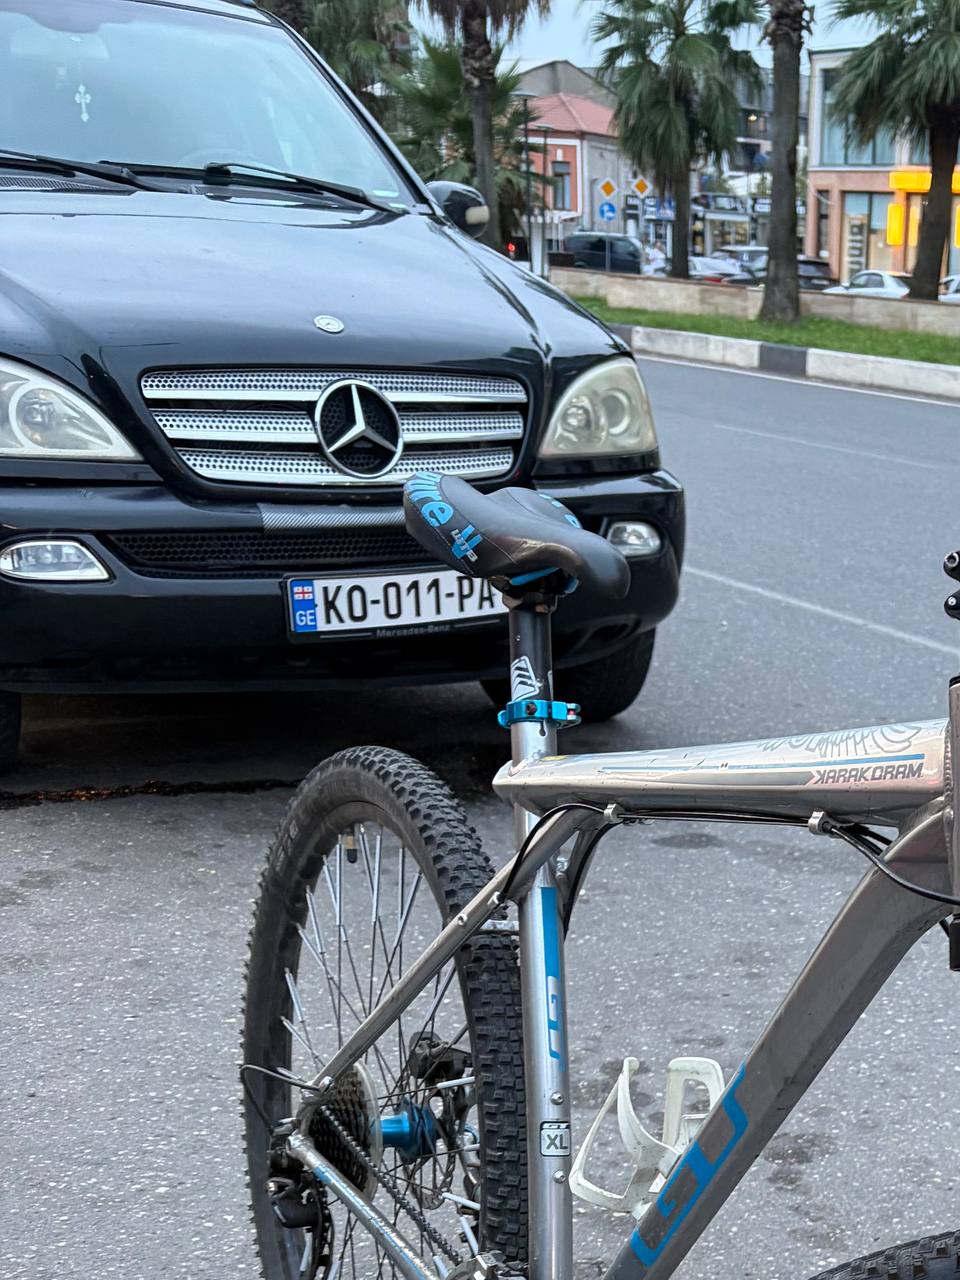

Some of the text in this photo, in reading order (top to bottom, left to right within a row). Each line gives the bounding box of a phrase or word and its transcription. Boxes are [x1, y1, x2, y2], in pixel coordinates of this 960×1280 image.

[322, 575, 496, 625] KO-011-PA
[295, 609, 315, 626] GE
[376, 624, 451, 638] Mercedes-Benz
[813, 762, 925, 785] KARAKORAM
[545, 1132, 569, 1151] XL
